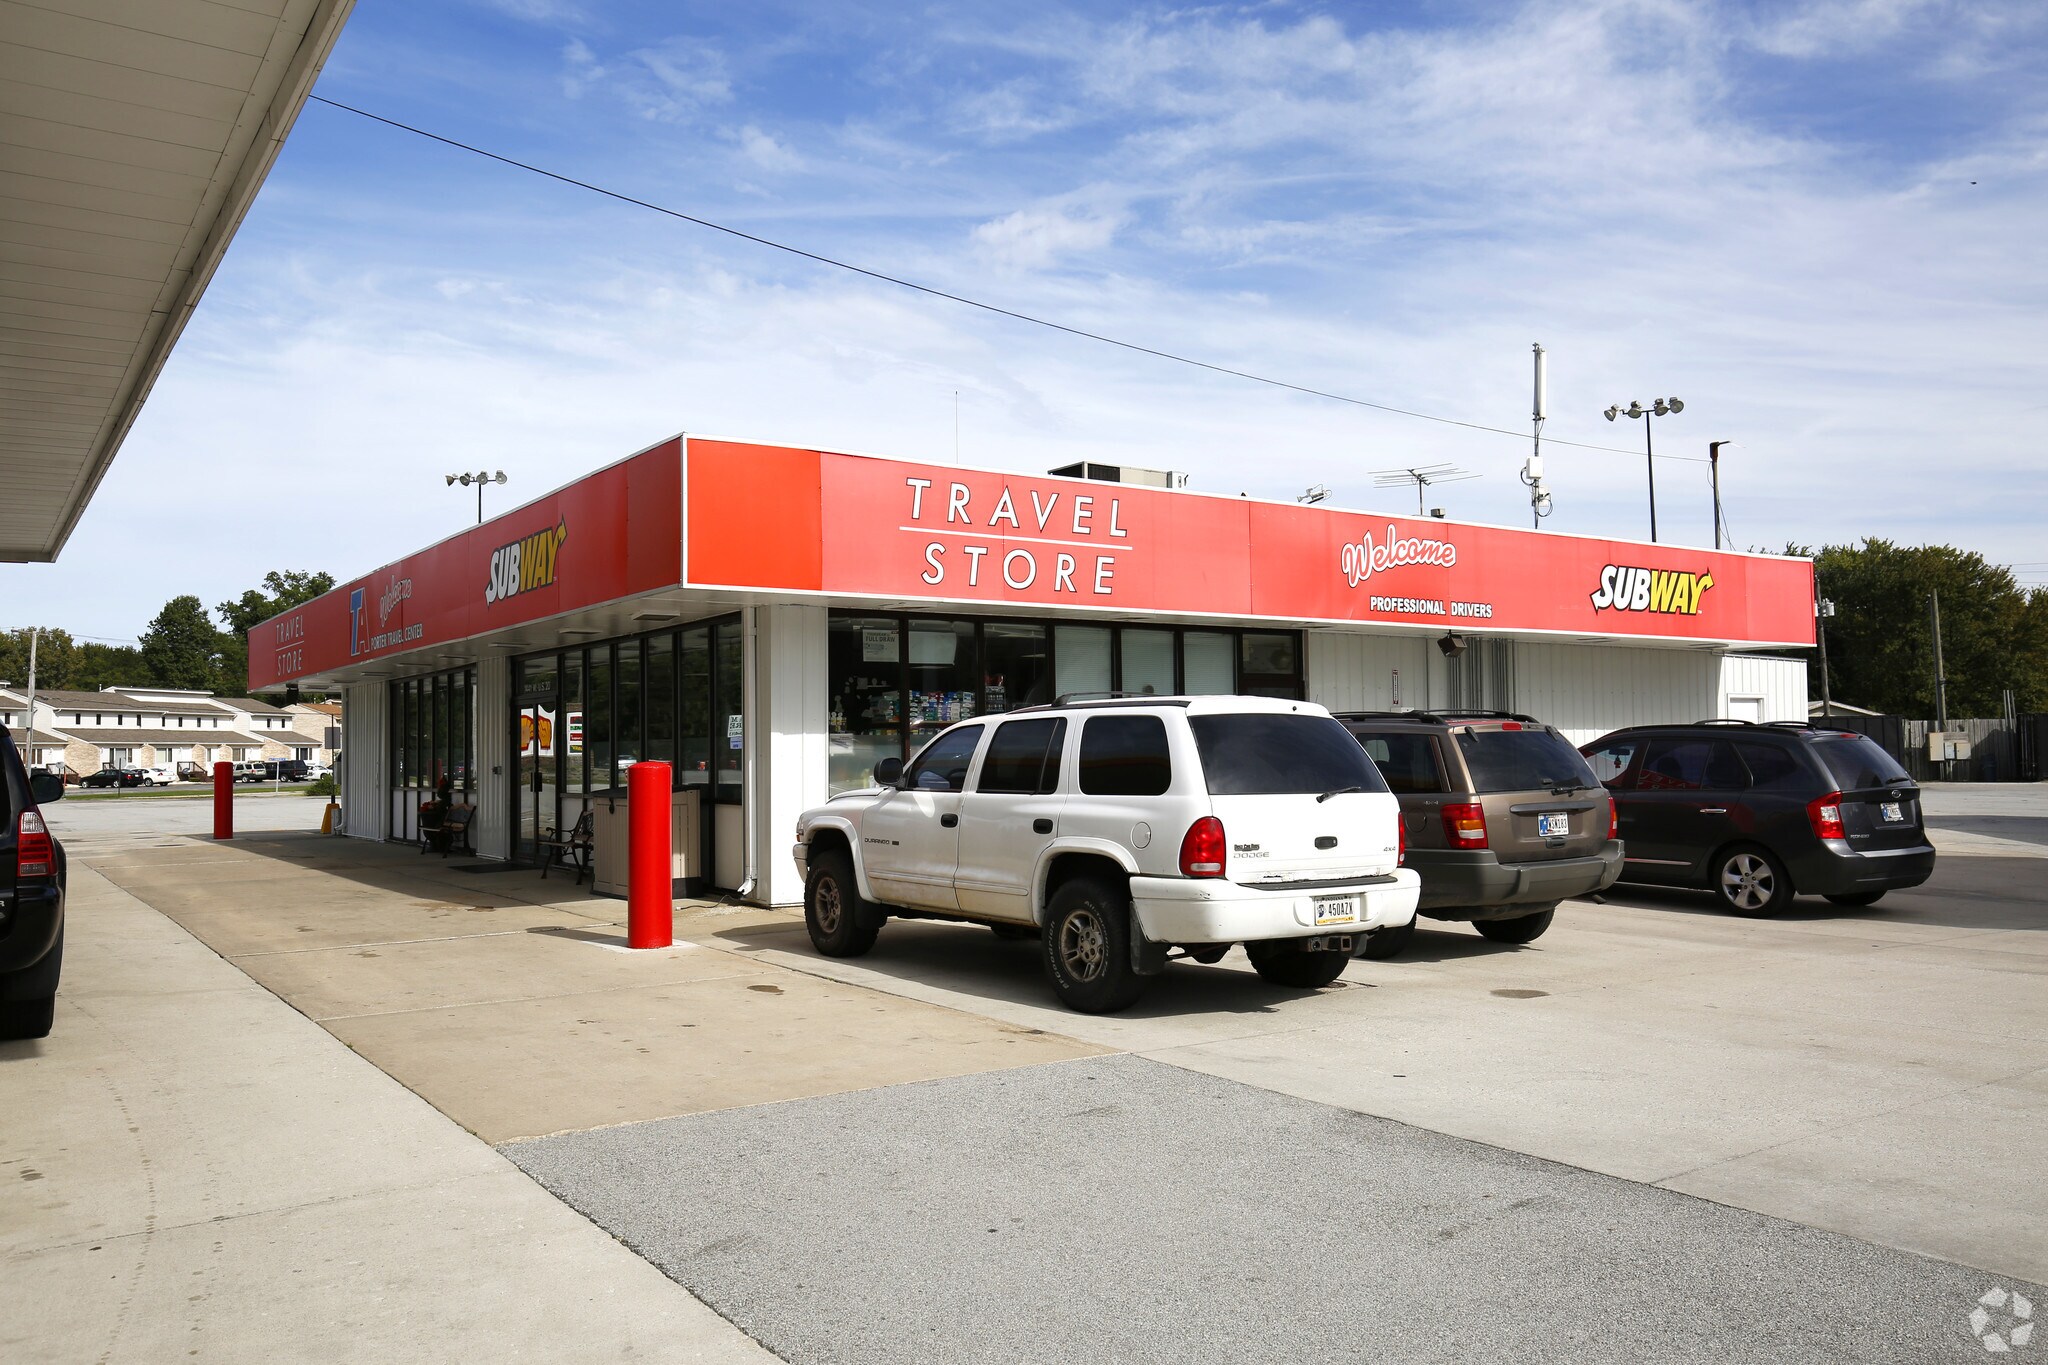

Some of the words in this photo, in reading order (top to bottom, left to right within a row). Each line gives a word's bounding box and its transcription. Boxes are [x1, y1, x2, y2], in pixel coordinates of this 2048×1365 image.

[906, 477, 1127, 537] TRAVEL
[485, 513, 567, 609] SUBWAY
[921, 542, 1115, 595] STORE
[1341, 523, 1456, 588] Welcome
[380, 575, 412, 628] Welcome
[1370, 595, 1446, 616] PROFESSIONAL
[1451, 601, 1493, 619] DRIVERS
[1589, 564, 1715, 616] SUBWAY
[276, 614, 304, 645] TRAVEL
[350, 587, 371, 657] TA
[371, 633, 388, 650] PORTER
[388, 629, 404, 643] TRAVEL
[404, 624, 423, 641] CENTER
[277, 649, 302, 676] STORE
[864, 837, 890, 845] DURANGO
[1328, 902, 1354, 917] 450AZX
